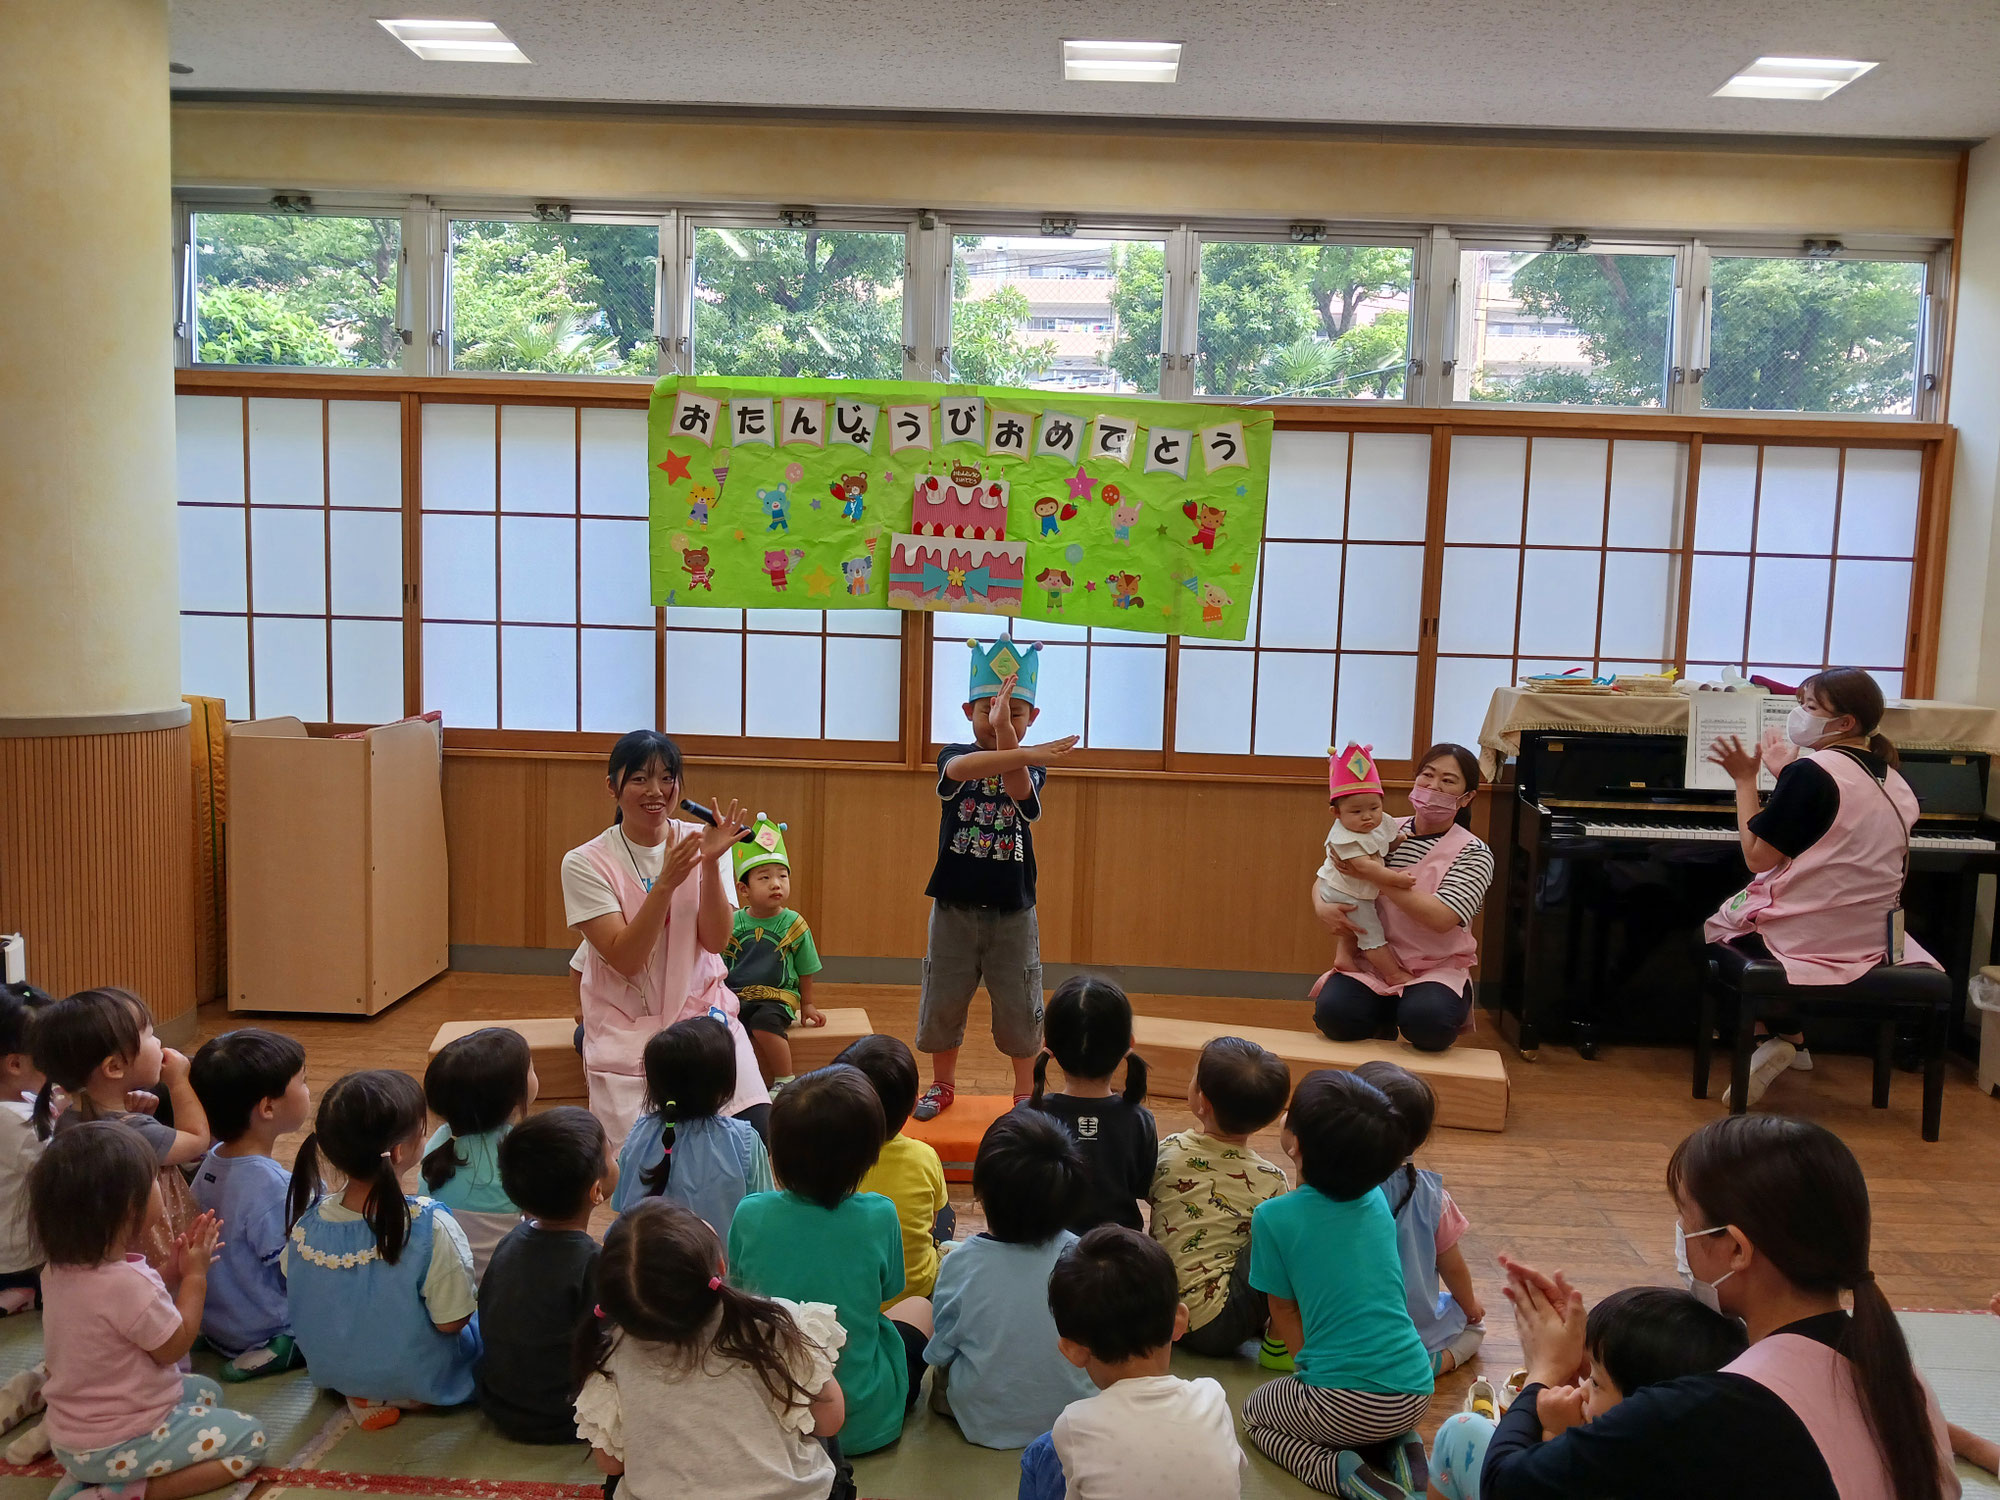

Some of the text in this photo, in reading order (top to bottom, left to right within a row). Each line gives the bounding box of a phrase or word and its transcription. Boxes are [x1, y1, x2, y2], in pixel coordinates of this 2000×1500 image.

[679, 403, 1237, 465] おたんじょうびおめでとう
[997, 656, 1012, 677] 5
[1354, 758, 1363, 774] 1
[760, 832, 774, 846] 3
[1014, 831, 1024, 863] SERIES
